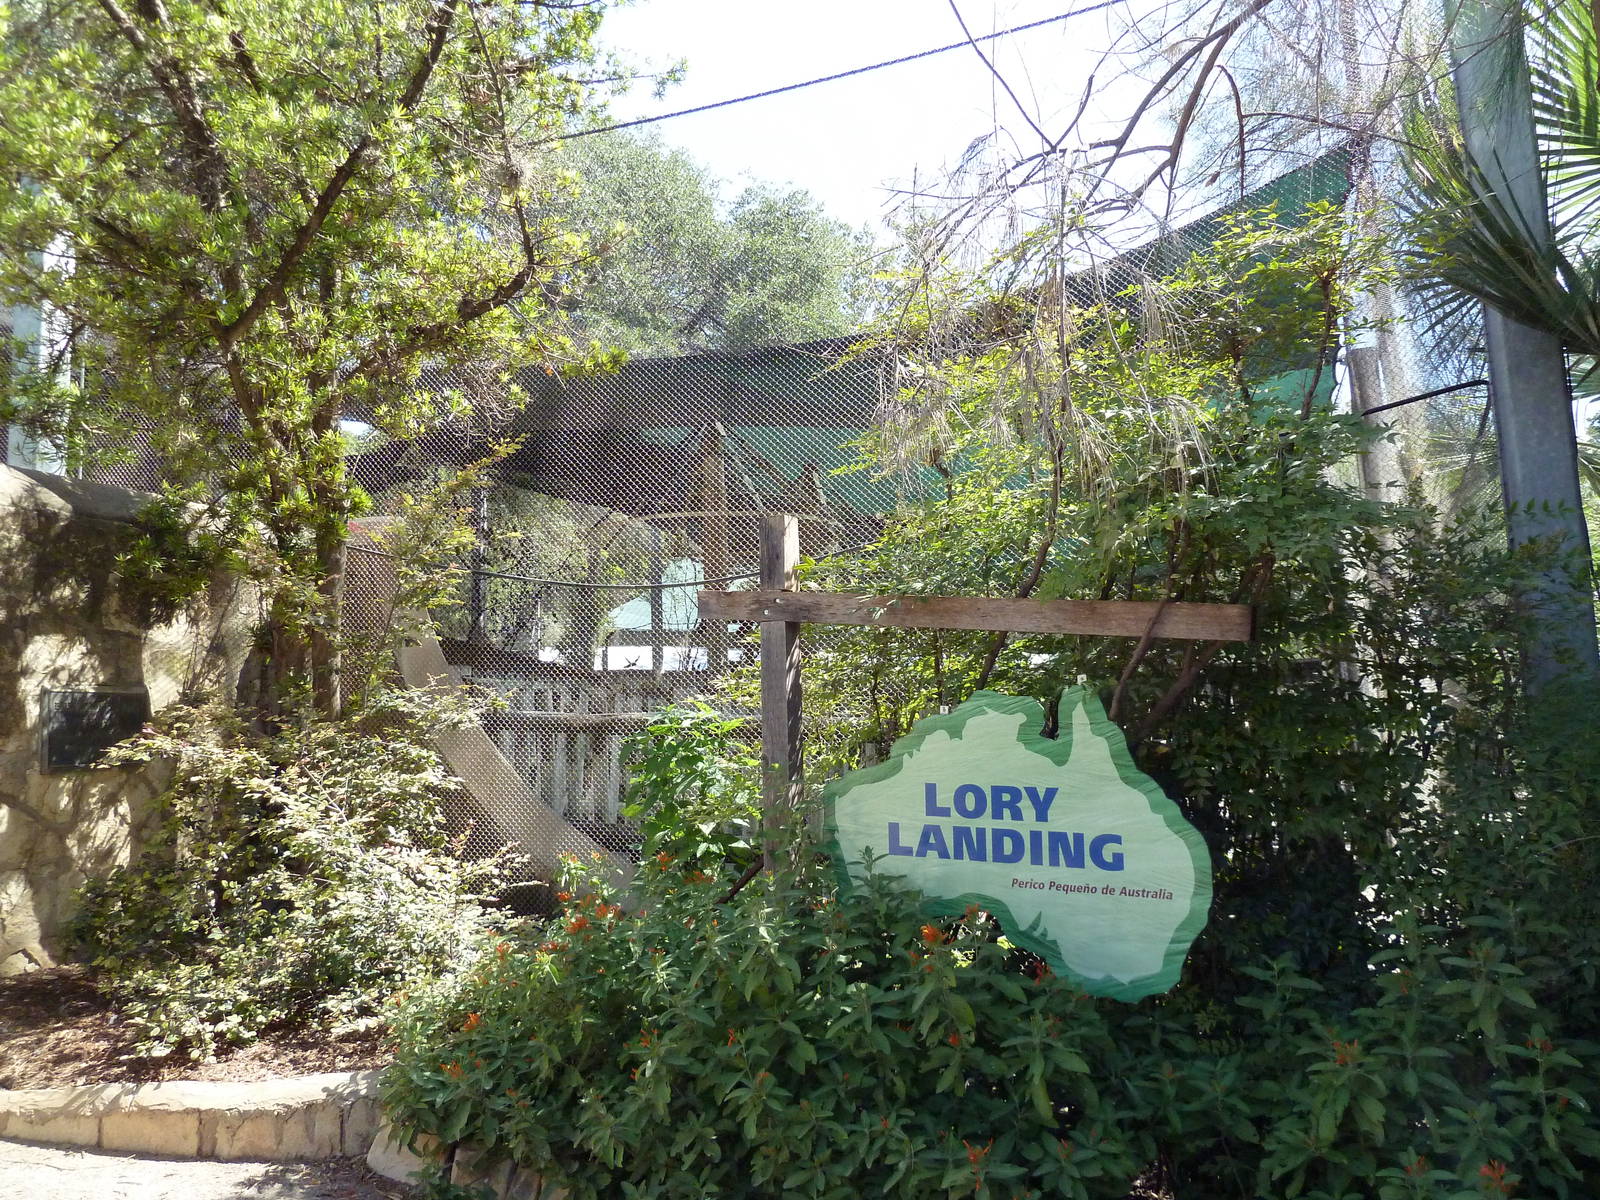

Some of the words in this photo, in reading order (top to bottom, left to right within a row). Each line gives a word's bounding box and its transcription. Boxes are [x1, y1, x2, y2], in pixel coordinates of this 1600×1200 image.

[925, 783, 1059, 822] LORY
[888, 822, 1125, 871] LANDING
[1011, 878, 1045, 890] Perico
[1048, 880, 1098, 895] Pequeño
[1101, 883, 1116, 896] de
[1119, 887, 1173, 900] Australia
